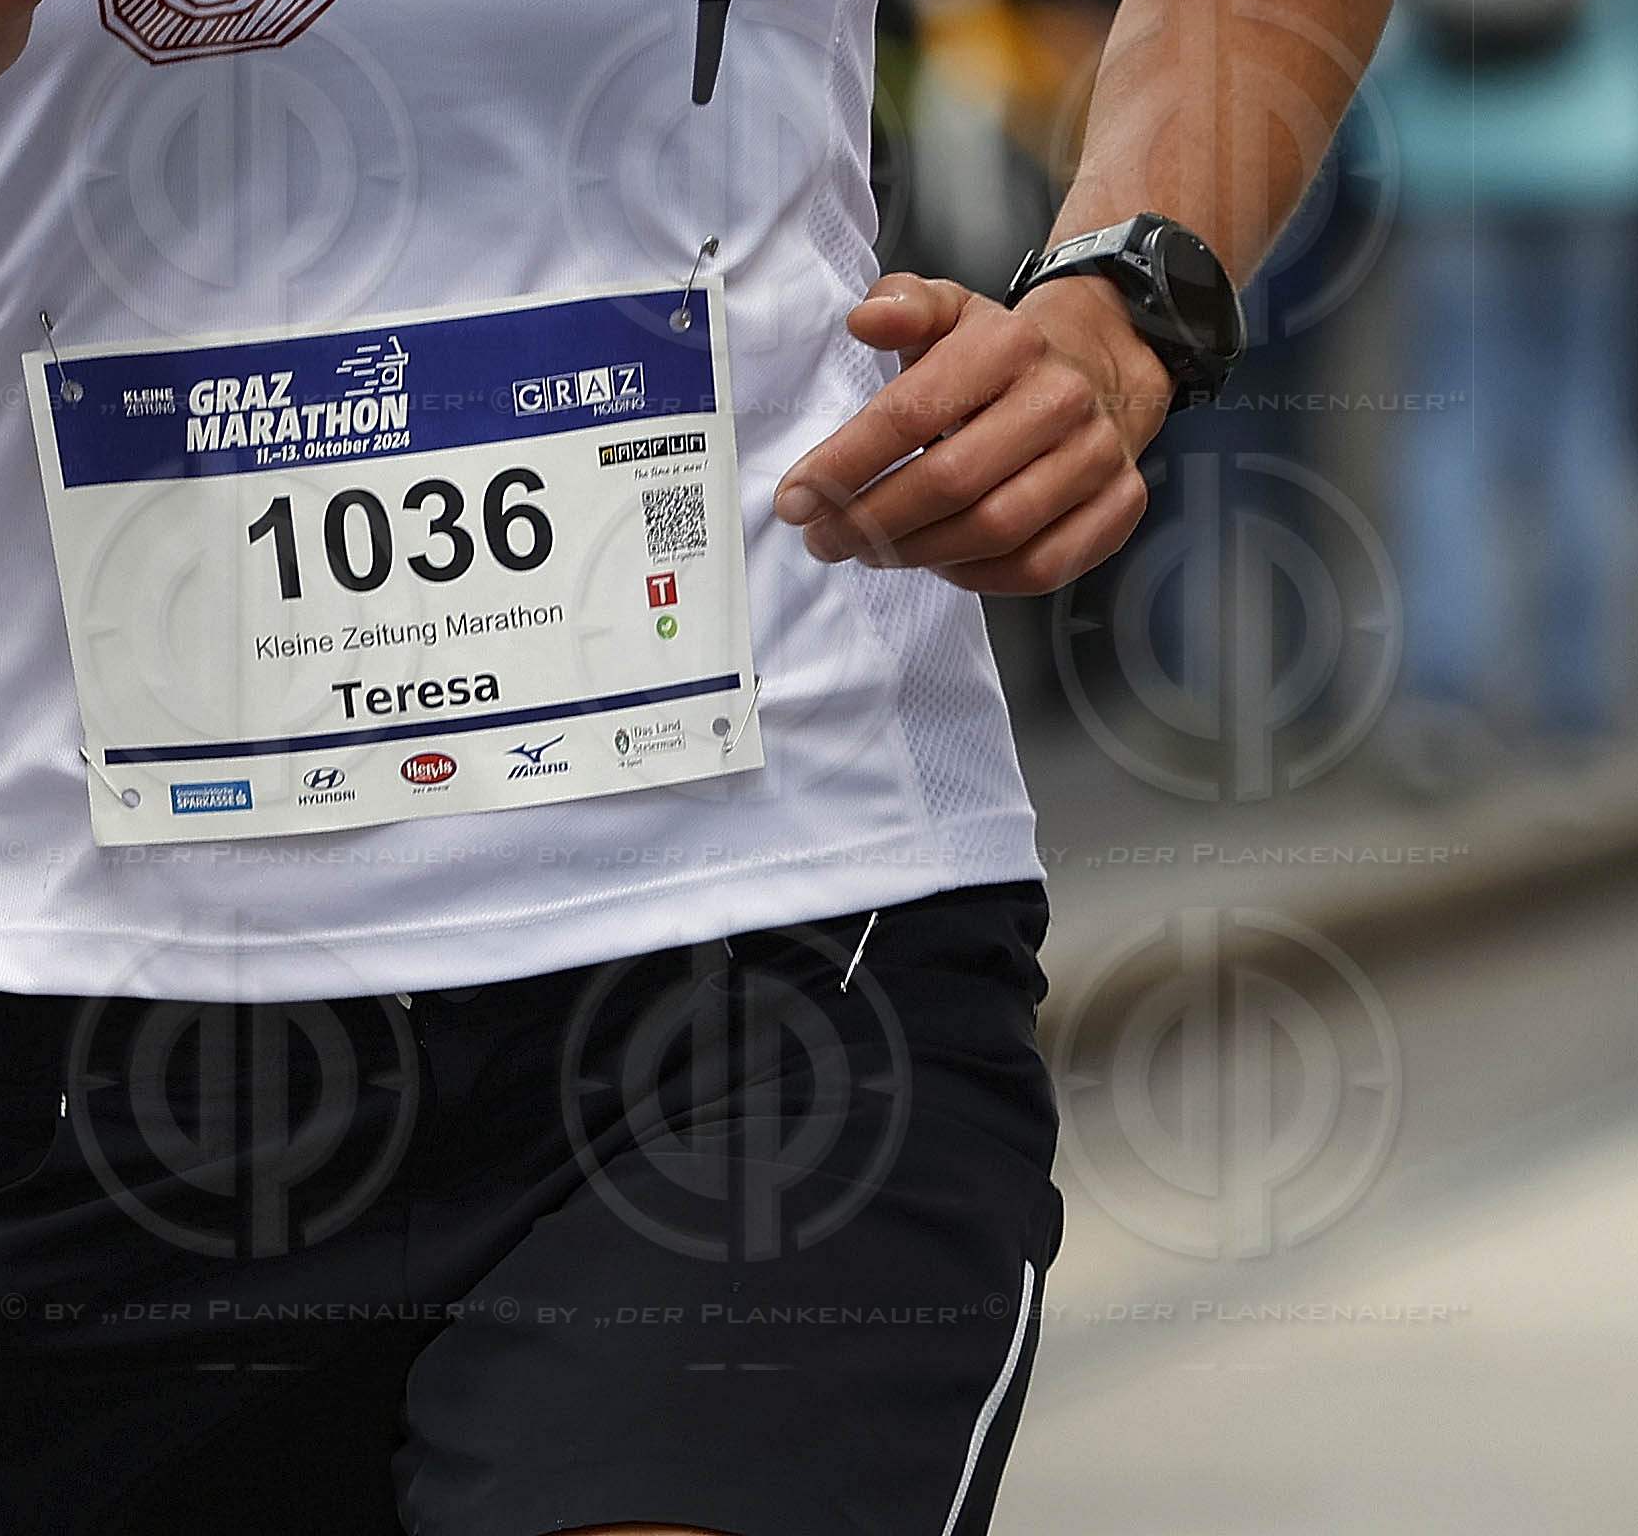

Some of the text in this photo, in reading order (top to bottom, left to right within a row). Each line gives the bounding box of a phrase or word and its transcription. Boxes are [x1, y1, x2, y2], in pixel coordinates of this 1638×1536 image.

[123, 386, 174, 405] KLEINE
[188, 370, 294, 415] GRAZ
[513, 363, 645, 416] GRAZ
[593, 396, 646, 417] HOLDING
[186, 393, 409, 453] MARATHON
[305, 435, 369, 459] Oktober
[372, 430, 411, 451] 2024
[248, 467, 553, 601] 1036
[255, 603, 564, 660] Kleine Zeitung Marathon
[331, 671, 500, 719] Teresa
[176, 793, 236, 810] SPARKASSE
[297, 790, 356, 806] HYUNDAI
